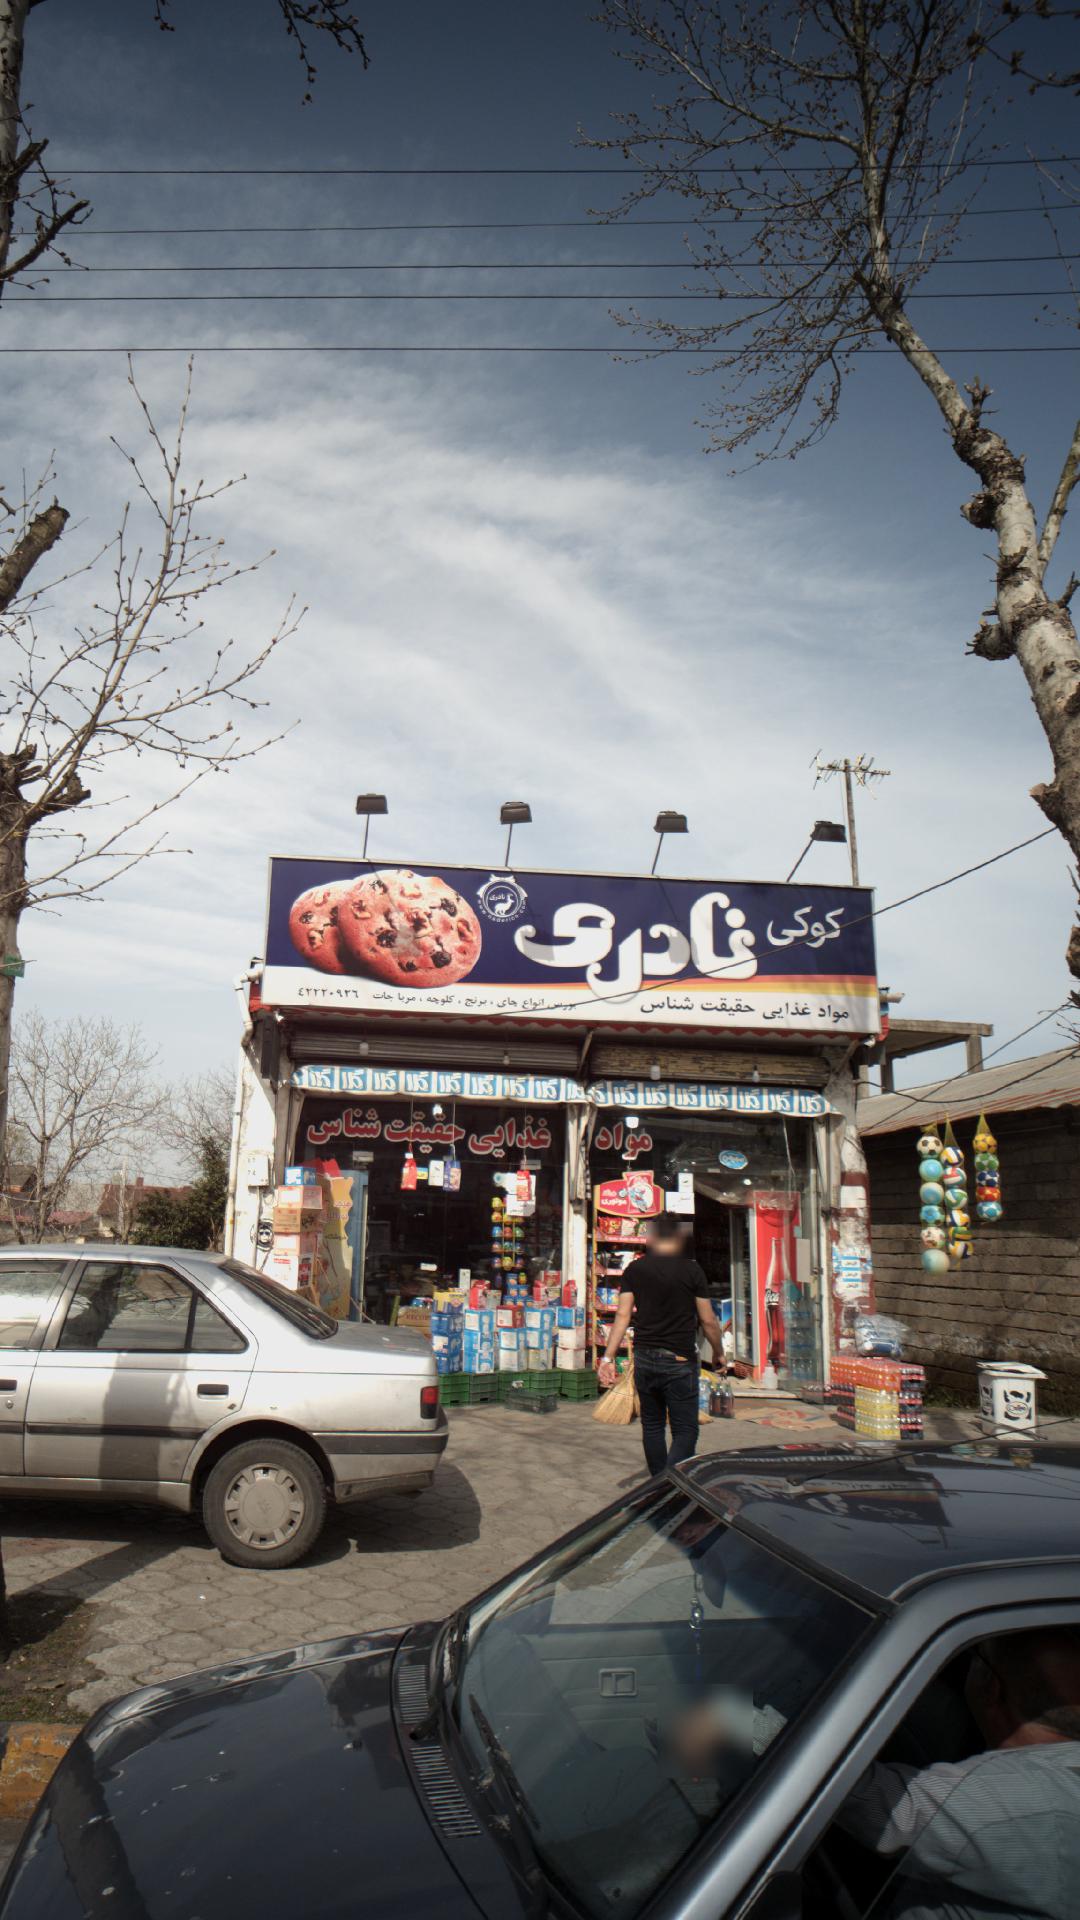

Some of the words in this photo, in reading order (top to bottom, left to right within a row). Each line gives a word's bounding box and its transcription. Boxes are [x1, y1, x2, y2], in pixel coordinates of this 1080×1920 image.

[766, 905, 846, 949] کوکی
[514, 891, 758, 1003] نادری
[372, 991, 394, 1001] جات
[397, 992, 417, 1005] مربا
[464, 995, 488, 1007] برنج
[521, 998, 545, 1010] انواع
[640, 996, 694, 1014] شناس
[700, 997, 755, 1017] حقیقت
[762, 1001, 811, 1021] غذایی
[817, 1004, 850, 1024] مواد
[307, 1107, 382, 1145] شناس
[384, 1110, 466, 1154] حقیقت
[468, 1115, 552, 1158] غذایی
[595, 1120, 653, 1161] مواد
